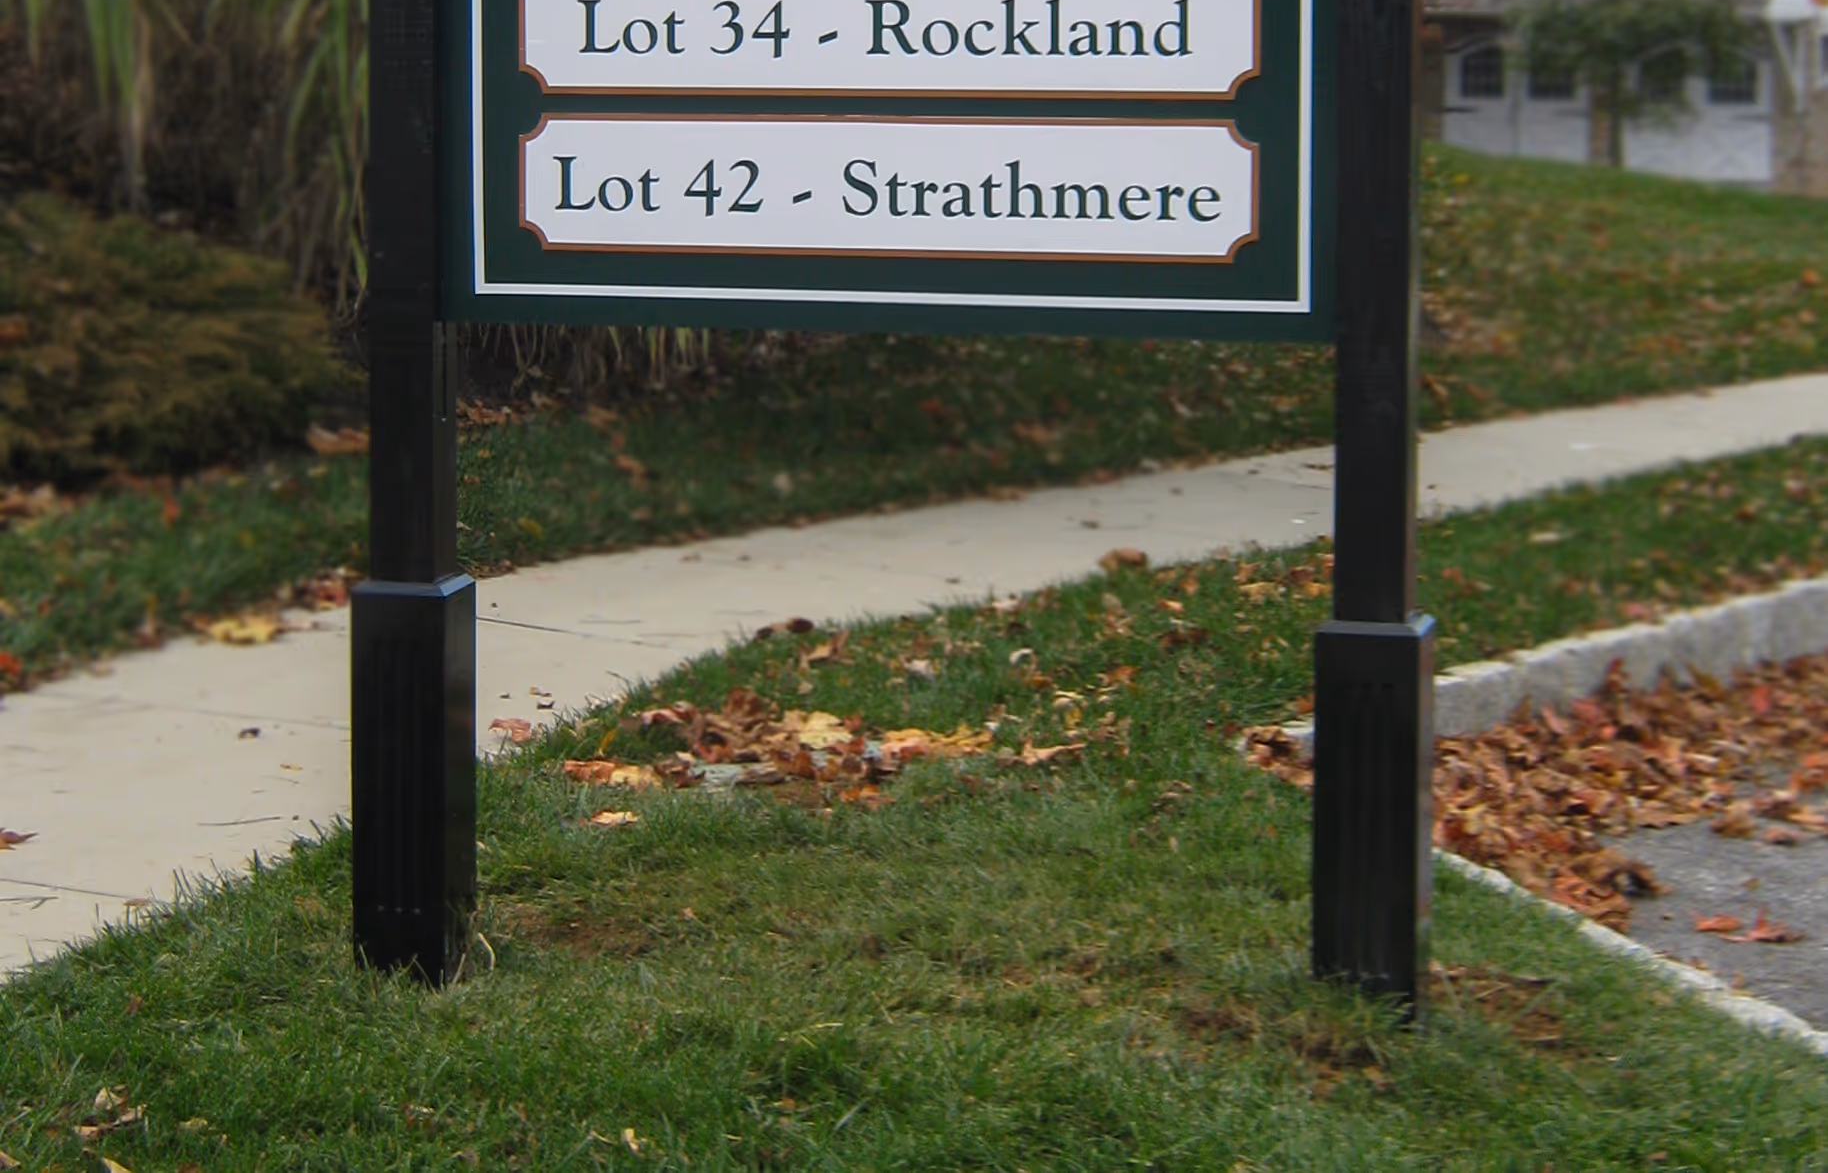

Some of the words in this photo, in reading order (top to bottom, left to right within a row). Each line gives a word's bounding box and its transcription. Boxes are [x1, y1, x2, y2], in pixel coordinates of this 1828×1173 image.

[577, 0, 684, 54] Lot
[711, 1, 790, 58] 34
[818, 30, 838, 45] -
[553, 156, 660, 211] Lot
[684, 159, 763, 216] 42
[792, 190, 812, 205] -
[843, 160, 1220, 221] Strathmere
